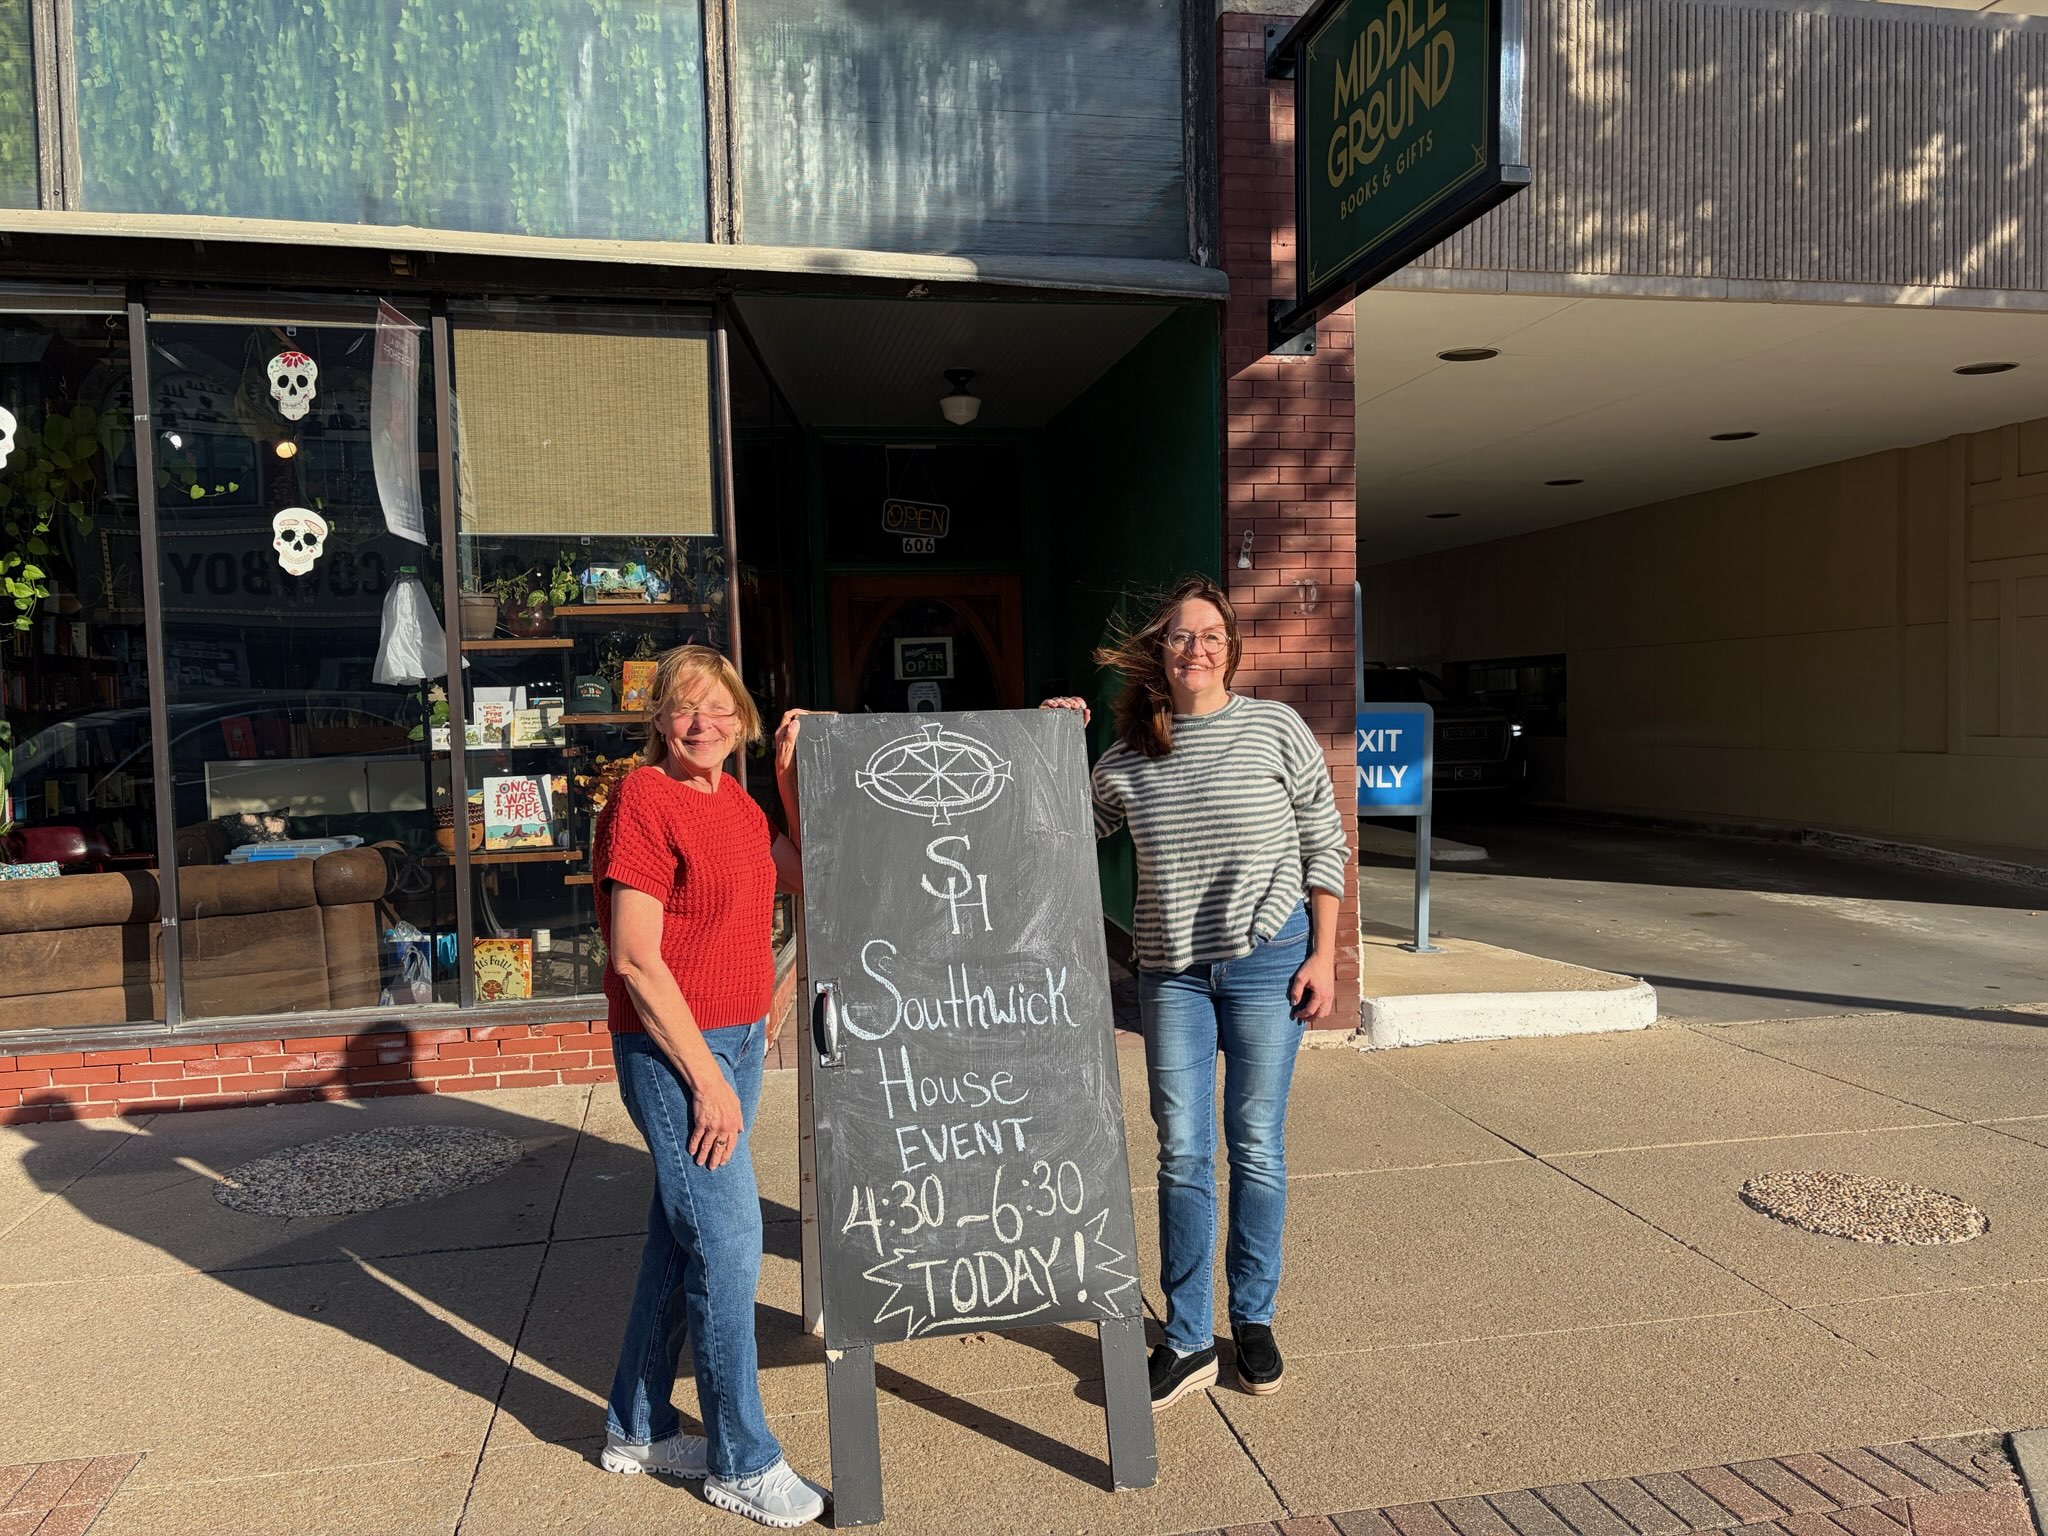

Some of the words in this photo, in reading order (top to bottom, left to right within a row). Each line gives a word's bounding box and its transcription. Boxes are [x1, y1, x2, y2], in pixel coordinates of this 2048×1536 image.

[1327, 30, 1455, 188] GROUND
[1340, 174, 1378, 220] BOOKS
[1382, 163, 1392, 188] &
[1396, 129, 1434, 175] GIFTS
[887, 504, 945, 532] OPEN
[904, 539, 934, 551] 606
[905, 660, 944, 673] OPEN
[1357, 729, 1403, 752] XIT
[499, 780, 537, 794] ONCE
[1357, 765, 1408, 788] NLY
[495, 795, 501, 807] I
[506, 792, 535, 805] WAS
[505, 801, 540, 820] TREE
[475, 957, 488, 970] It's
[489, 955, 512, 970] Fall!
[895, 1116, 1034, 1173] EVENT
